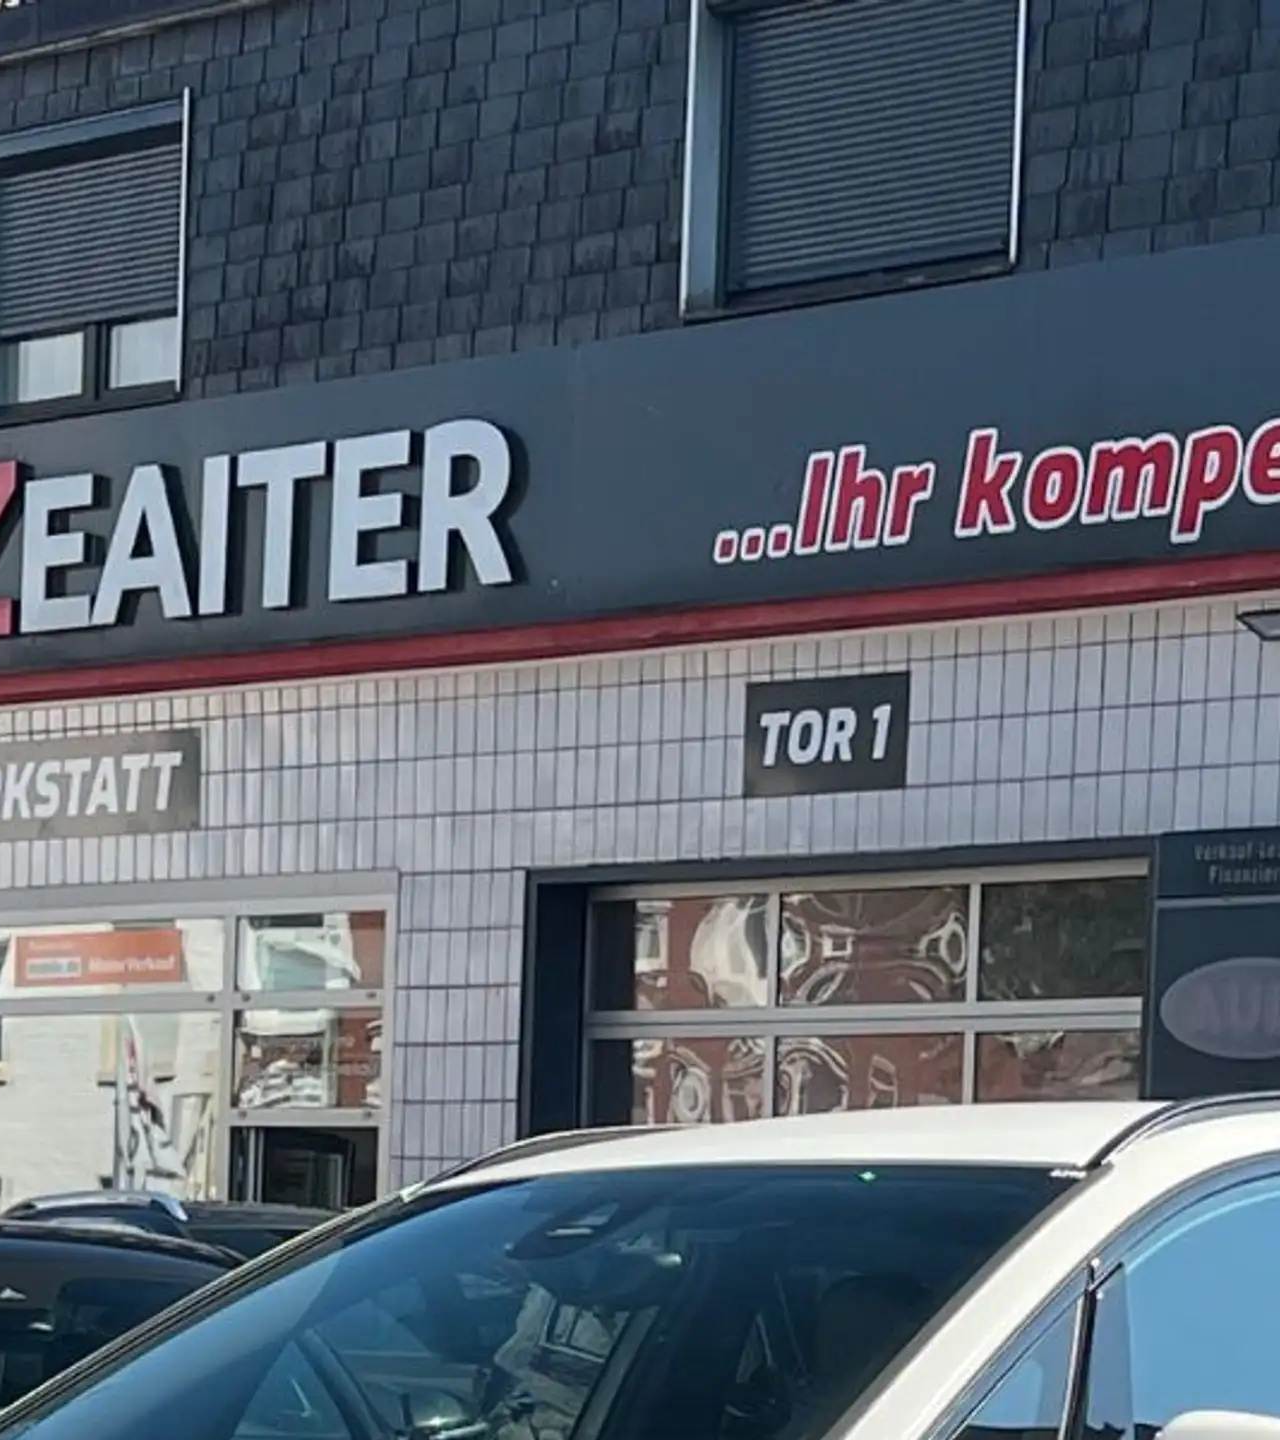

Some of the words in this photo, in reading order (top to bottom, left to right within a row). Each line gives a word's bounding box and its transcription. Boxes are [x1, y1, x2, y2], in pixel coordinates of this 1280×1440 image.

[714, 443, 934, 564] ...Ihr
[759, 708, 856, 767] TOR
[871, 703, 892, 760] 1
